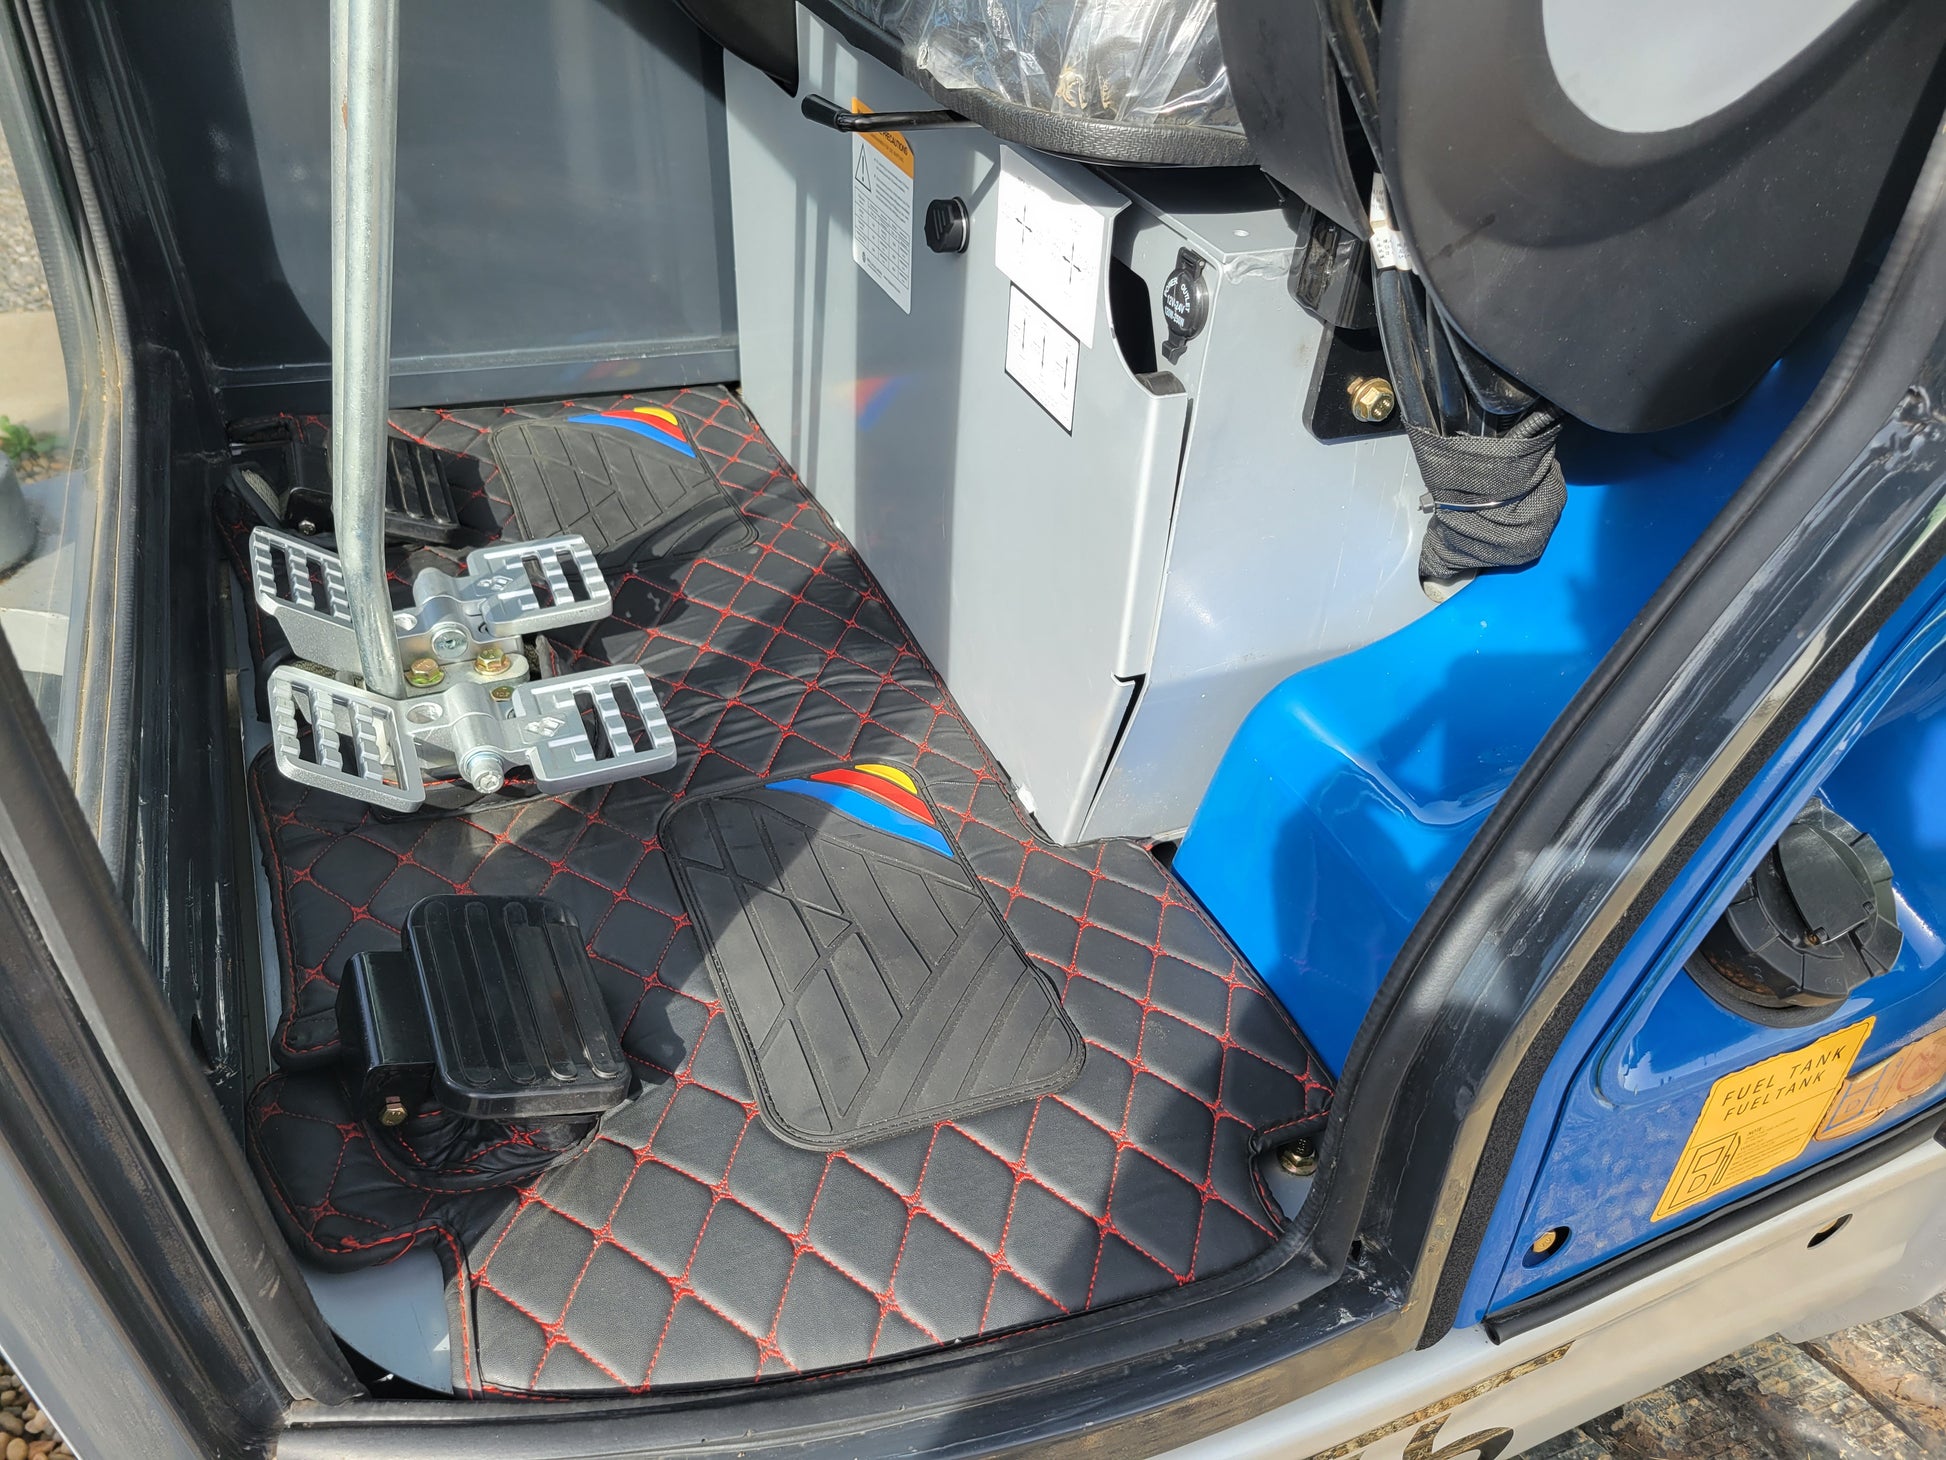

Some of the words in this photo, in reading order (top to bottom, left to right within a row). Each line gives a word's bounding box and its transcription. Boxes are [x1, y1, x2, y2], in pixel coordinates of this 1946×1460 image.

[1167, 294, 1185, 314] 12V-24V
[1181, 283, 1190, 313] OUTLET
[1722, 1074, 1775, 1106] FUEL
[1790, 1045, 1847, 1079] TANK
